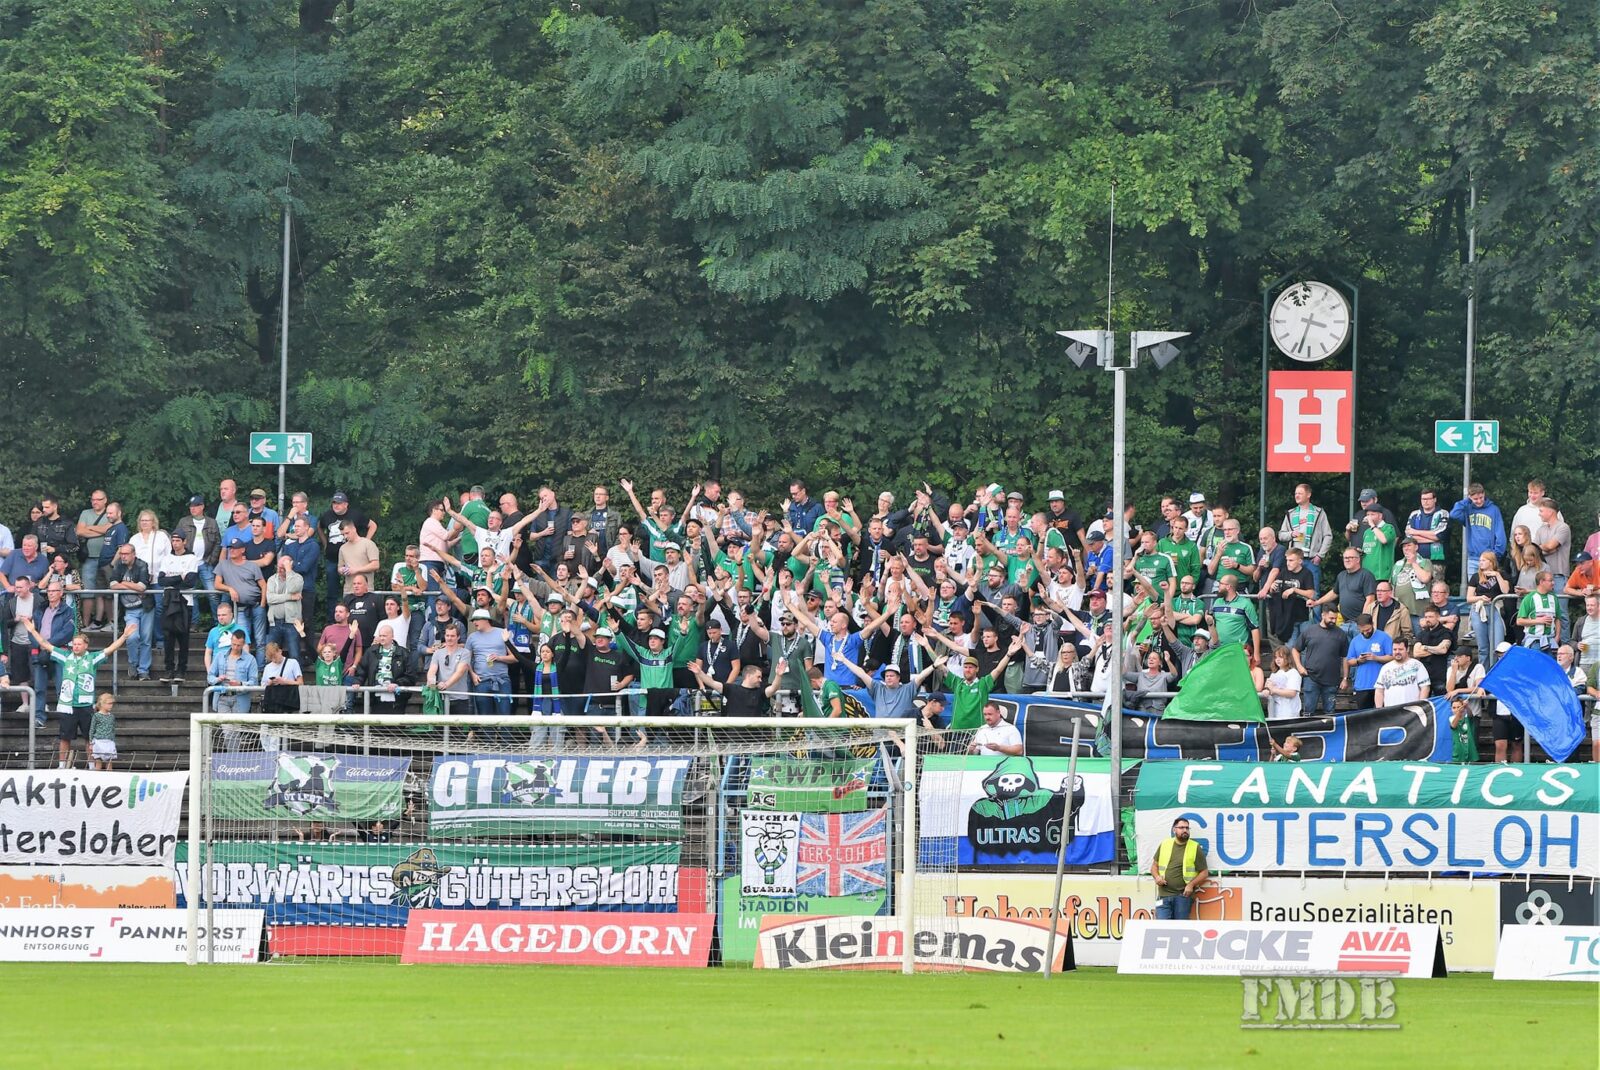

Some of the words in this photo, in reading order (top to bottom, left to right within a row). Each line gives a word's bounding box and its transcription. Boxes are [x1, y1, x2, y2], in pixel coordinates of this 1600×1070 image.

[1274, 388, 1347, 454] H
[217, 764, 261, 778] Support
[433, 759, 506, 807] GT
[555, 760, 689, 805] LEBT
[0, 775, 123, 809] Aktive
[1177, 764, 1581, 806] FANATICS
[298, 793, 323, 803] LEBT
[608, 809, 638, 817] SUPPORT
[743, 813, 799, 822] VECCHIA
[0, 820, 176, 856] tersloher
[977, 827, 1040, 844] ULTRAS
[176, 856, 394, 905] VORWÄRTS
[440, 858, 677, 906] GÜTERSLOH
[738, 901, 808, 912] STADION
[1250, 901, 1453, 925] BrauSpezialitäten
[738, 917, 757, 929] IM
[23, 943, 90, 951] ENTSORGUNG
[418, 922, 698, 955] HAGEDORN
[772, 921, 1045, 973] Kleinemas
